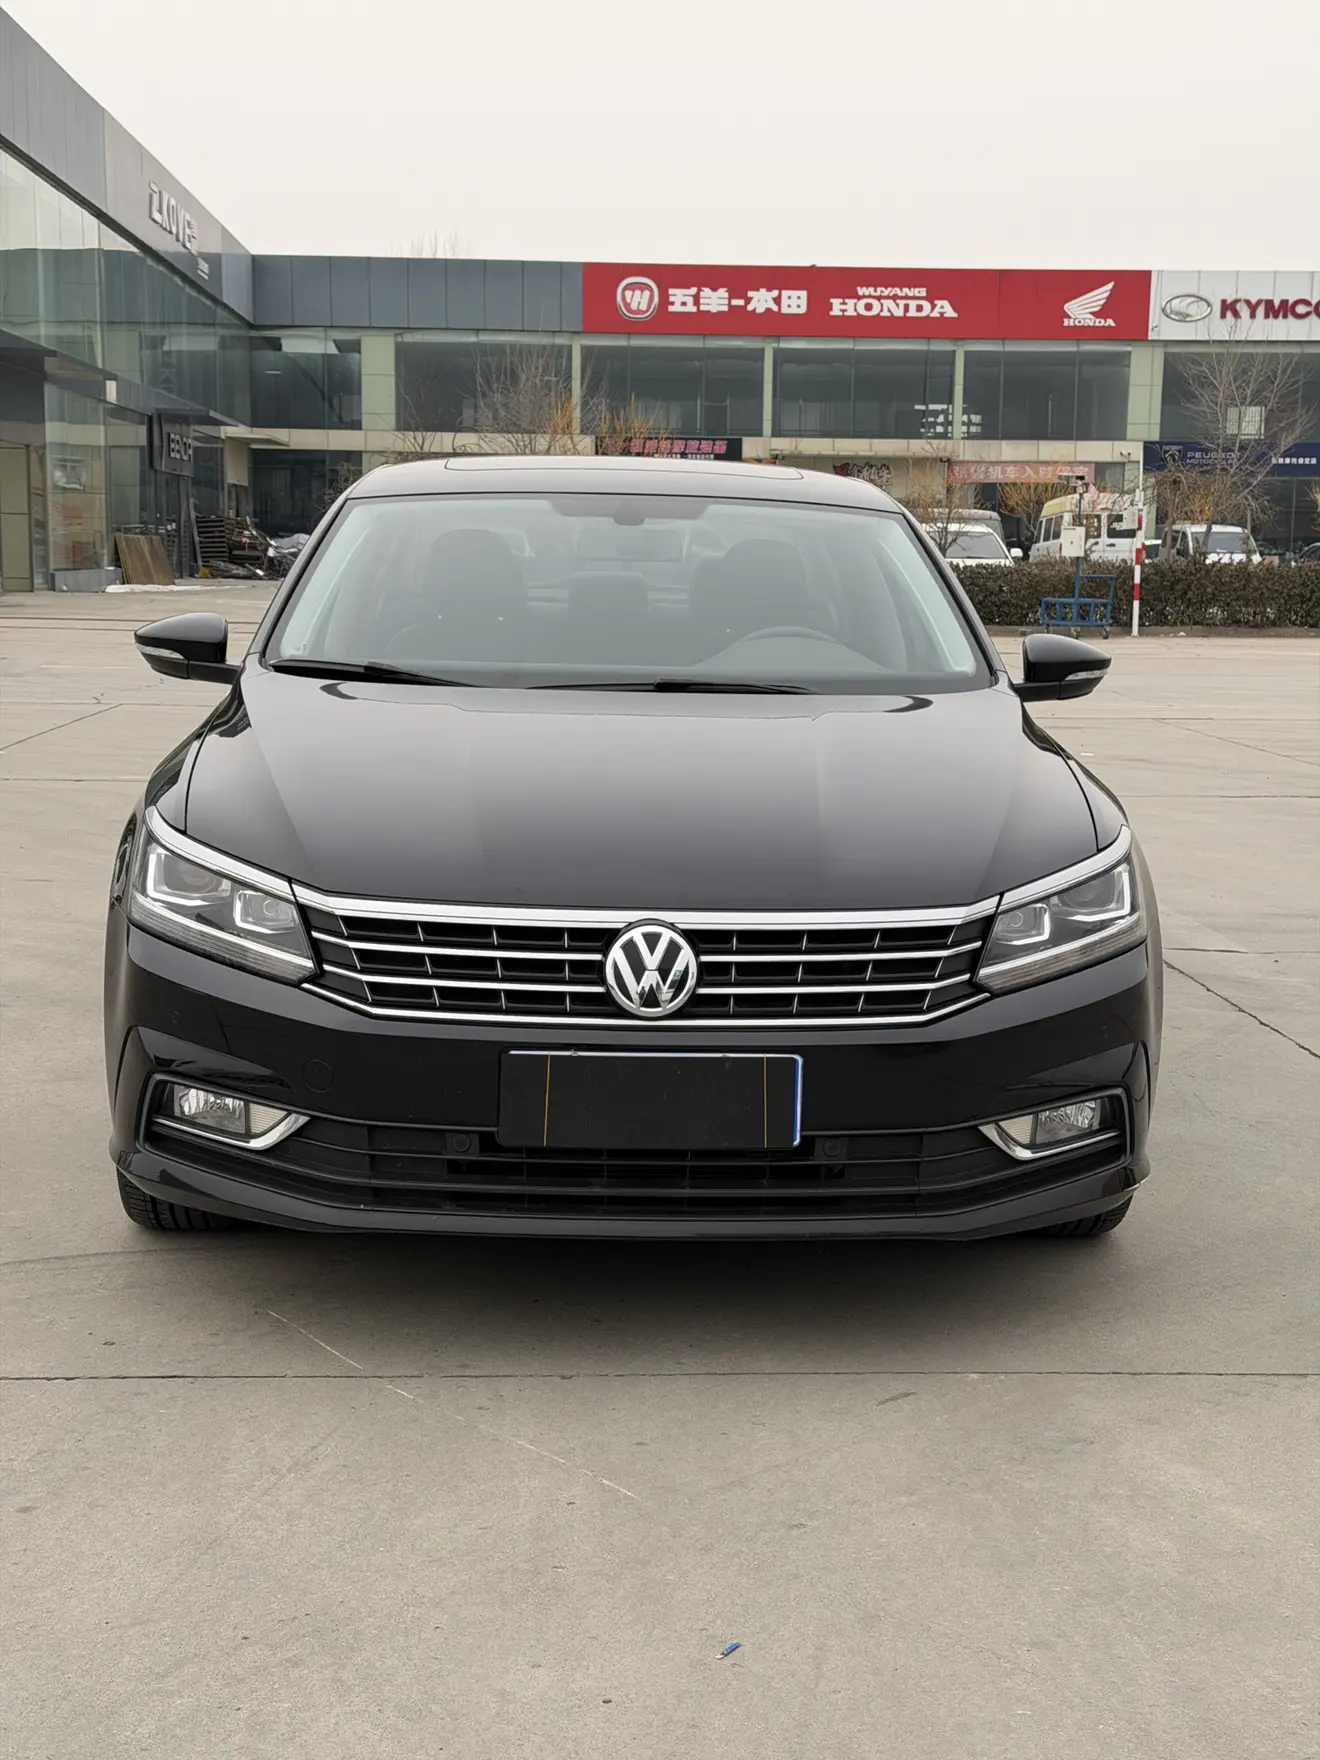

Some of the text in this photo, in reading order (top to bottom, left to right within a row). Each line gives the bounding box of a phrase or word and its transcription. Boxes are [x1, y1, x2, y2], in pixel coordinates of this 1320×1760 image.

[856, 286, 927, 297] WUYANG
[829, 298, 958, 318] HONDA
[1062, 317, 1116, 327] HONDA
